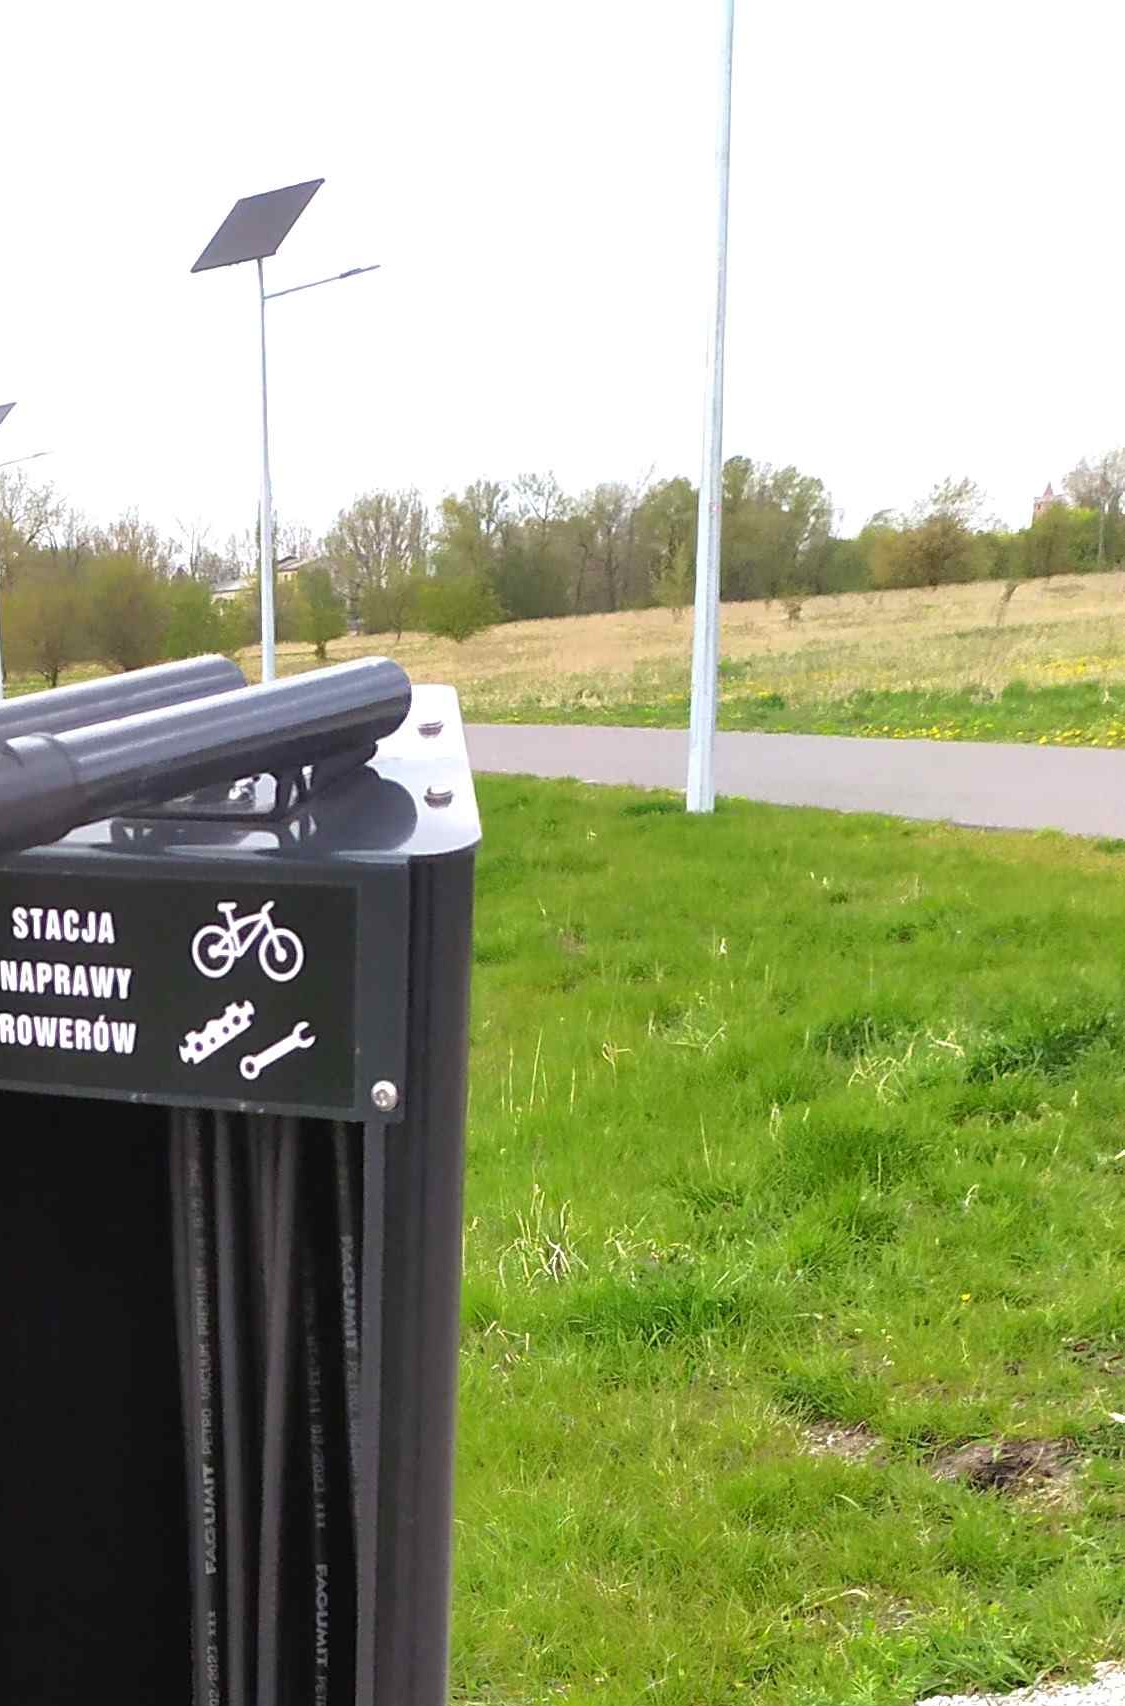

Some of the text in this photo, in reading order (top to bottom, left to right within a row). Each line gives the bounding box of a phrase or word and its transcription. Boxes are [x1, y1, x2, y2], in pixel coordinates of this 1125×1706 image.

[11, 906, 115, 945] STACJA
[0, 960, 132, 1001] NAPRAWY
[202, 1463, 218, 1576] FAGUMIT
[315, 1563, 329, 1667] FAGUMIT
